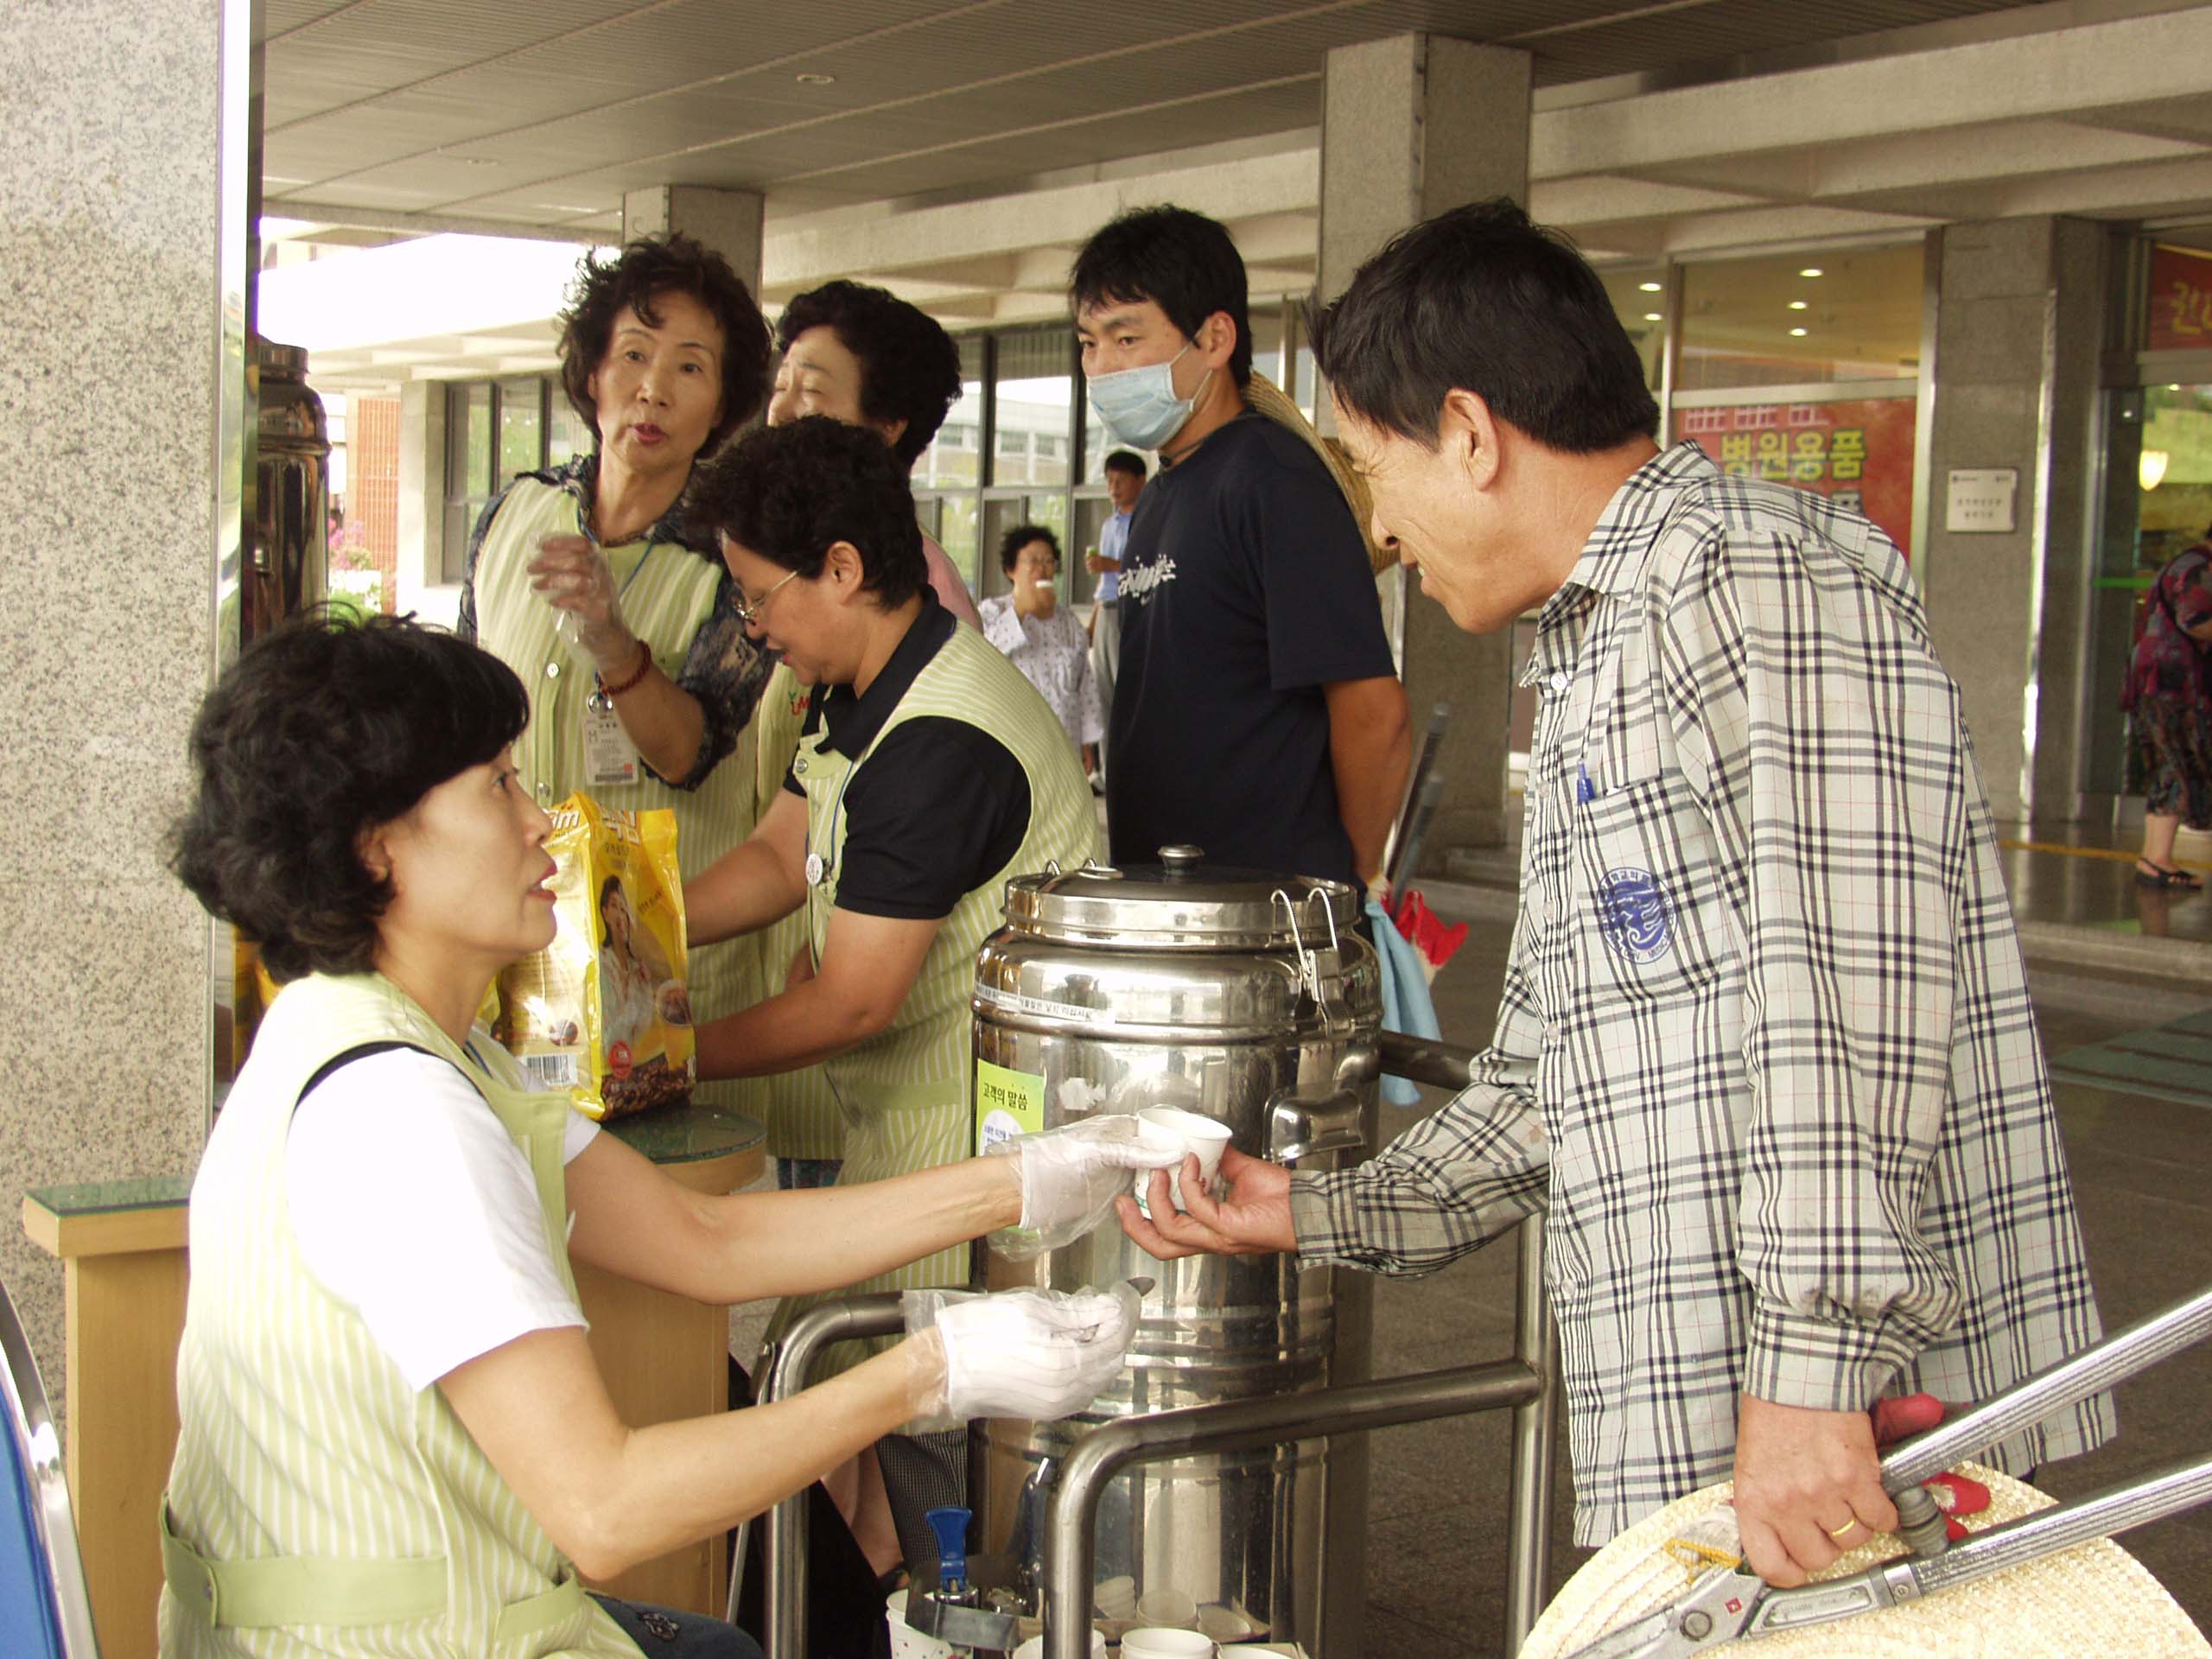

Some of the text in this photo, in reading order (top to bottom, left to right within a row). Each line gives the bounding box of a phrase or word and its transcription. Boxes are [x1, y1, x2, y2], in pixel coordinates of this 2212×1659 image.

[1720, 429, 1866, 480] 병원용품
[983, 1083, 1028, 1111] 고객의 말씀
